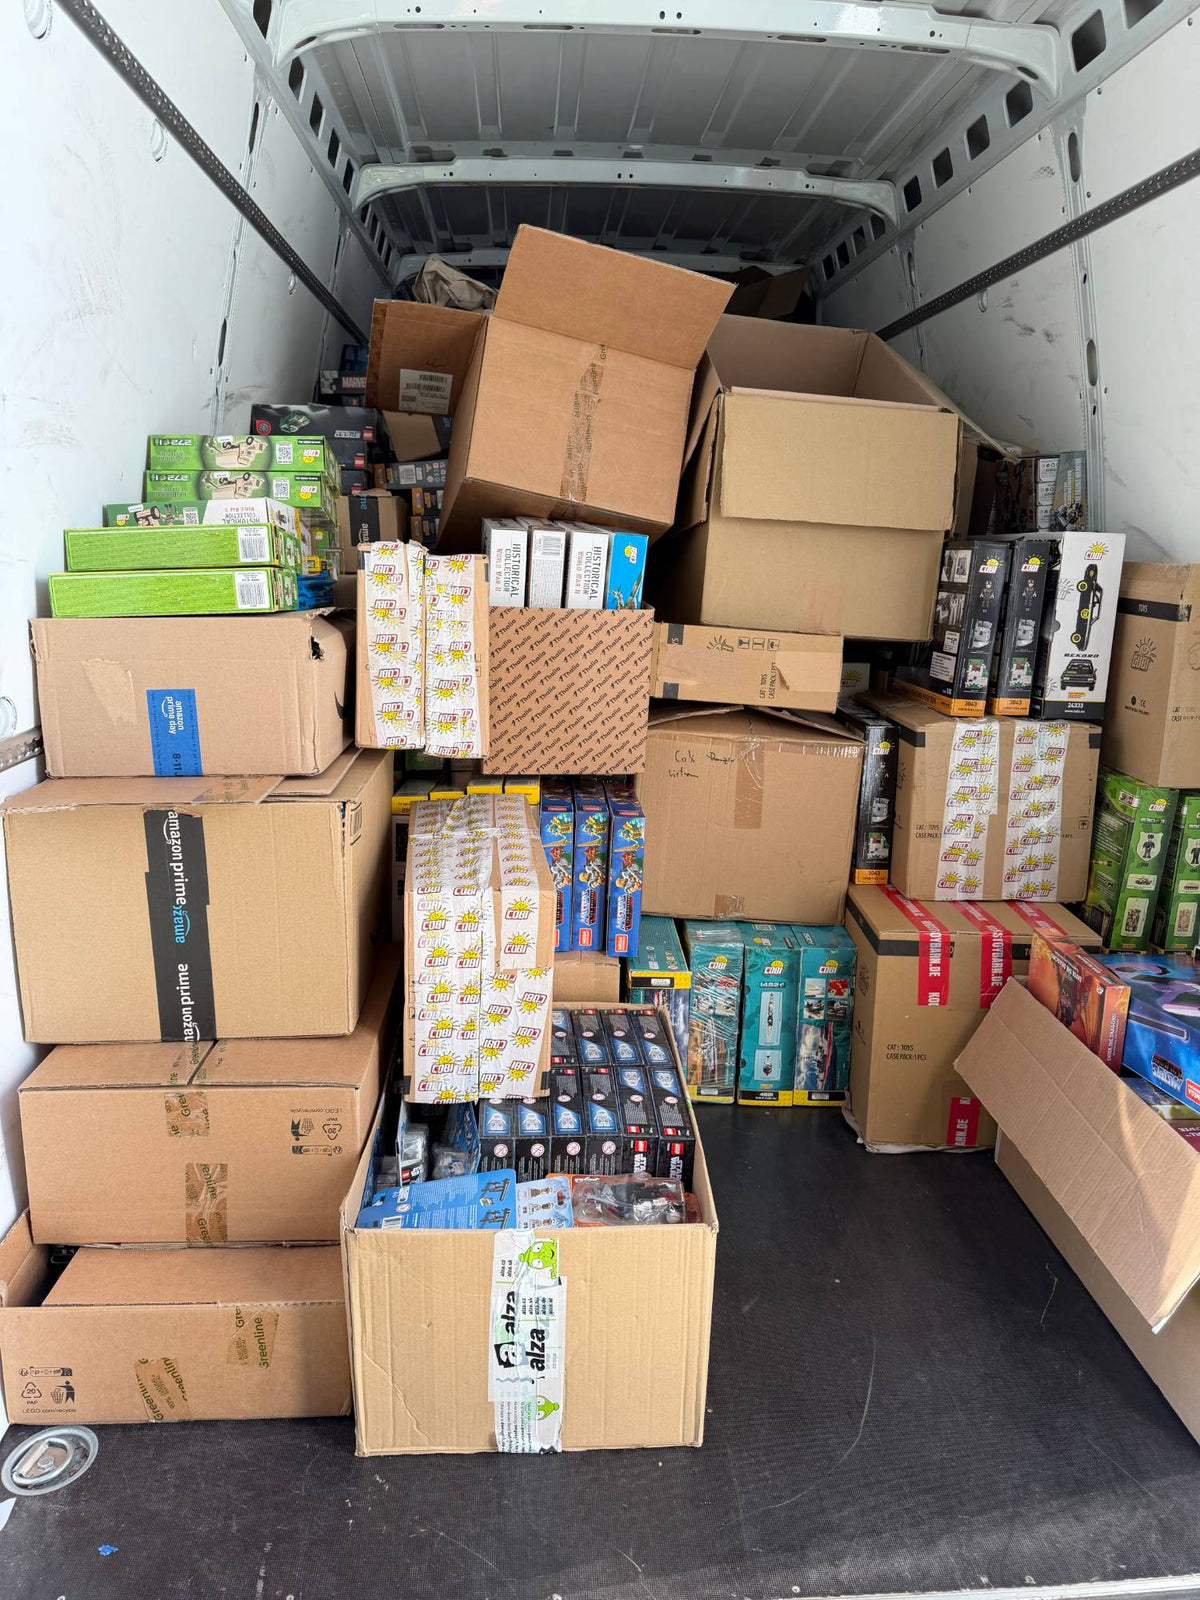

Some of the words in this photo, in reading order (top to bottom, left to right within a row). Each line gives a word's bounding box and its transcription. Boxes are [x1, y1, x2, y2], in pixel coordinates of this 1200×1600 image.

[342, 376, 366, 388] MARVE
[576, 551, 584, 571] WORLD
[1021, 564, 1040, 572] COBI
[373, 565, 395, 574] COBI
[503, 548, 511, 592] COLLECTION
[511, 544, 521, 597] HISTORICAL
[583, 552, 592, 594] COLLECTION
[590, 547, 602, 600] HISTORICAL
[495, 571, 503, 584] WAR
[451, 586, 471, 596] COBI
[375, 600, 396, 609] COBI
[558, 609, 575, 624] Thalia
[500, 619, 516, 634] Thalia
[592, 621, 608, 636] Thalia
[553, 628, 570, 643] Thalia
[450, 642, 471, 652] COBI
[605, 636, 622, 651] Thalia
[549, 648, 565, 662] Thalia
[620, 651, 636, 666] Thalia
[544, 667, 560, 681] Thalia
[615, 670, 631, 685] Thalia
[540, 686, 556, 700] Thalia
[610, 689, 626, 704] Thalia
[166, 696, 176, 719] prime
[535, 704, 551, 718] Thalia
[175, 701, 184, 730] amazon
[587, 712, 603, 726] Thalia
[168, 720, 177, 735] day
[511, 726, 527, 740] Thalia
[582, 730, 598, 744] Thalia
[507, 745, 523, 759] Thalia
[596, 744, 612, 758] Thalia
[541, 756, 556, 769] Thalia
[168, 811, 183, 861] amazon
[170, 863, 188, 906] prime
[417, 886, 441, 895] COBI
[453, 887, 477, 896] COBI
[173, 904, 186, 944] amaz
[422, 920, 445, 931] COBI
[455, 922, 479, 932] COBI
[504, 944, 528, 954] COBI
[425, 957, 448, 966] COBI
[708, 962, 727, 970] COBI
[819, 966, 838, 974] COBI
[176, 964, 195, 1006] prime
[427, 993, 450, 1002] COBI
[522, 992, 546, 1004] COBI
[488, 1004, 512, 1016] COBI
[429, 1029, 452, 1038] COBI
[457, 1030, 478, 1039] COB
[483, 1039, 507, 1049] COBI
[457, 1065, 477, 1075] COB
[511, 1060, 535, 1072] COBI
[502, 1291, 516, 1335] alza
[253, 1317, 270, 1368] Greenline
[526, 1328, 546, 1372] alza
